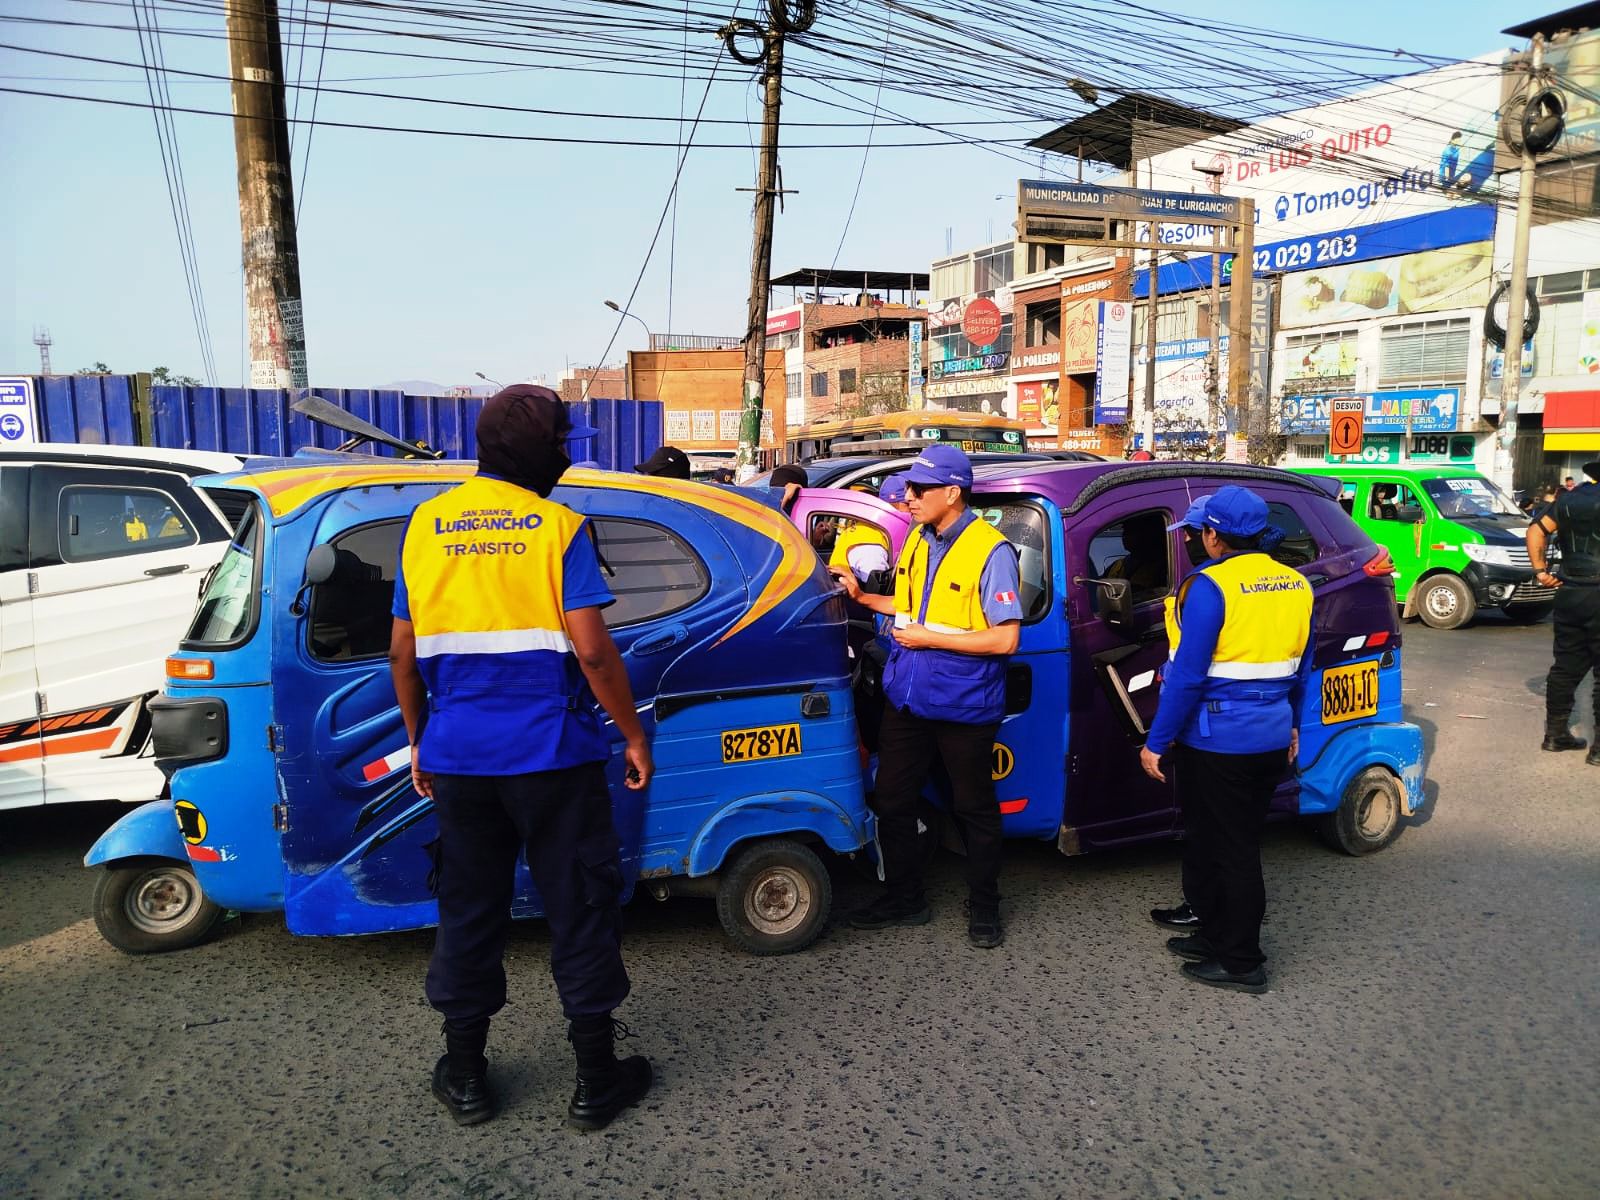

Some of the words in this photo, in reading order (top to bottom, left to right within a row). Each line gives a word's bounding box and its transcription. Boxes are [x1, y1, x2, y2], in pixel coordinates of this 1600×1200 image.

[1237, 161, 1263, 181] DR.
[1269, 143, 1313, 173] LUIS
[1321, 123, 1392, 161] QUITO
[1025, 188, 1099, 203] MUNICIPALIDAD
[1102, 193, 1115, 204] DE
[1140, 196, 1162, 209] JUAN
[1165, 198, 1176, 209] DE
[1179, 199, 1234, 213] LURIGANCHO
[1293, 166, 1434, 216] Tomografía
[1275, 242, 1312, 267] 029
[1316, 234, 1357, 262] 203
[1012, 356, 1022, 369] LA
[1335, 402, 1362, 410] DESVIO
[963, 442, 972, 450] 13
[434, 513, 543, 535] LURIGANCHO
[461, 509, 478, 518] SAN
[478, 508, 499, 517] JUAN
[500, 508, 513, 517] DE
[1239, 580, 1304, 594] LURIGANCHO
[1323, 668, 1378, 717] 8881-IC
[723, 723, 800, 761] 8278-YA
